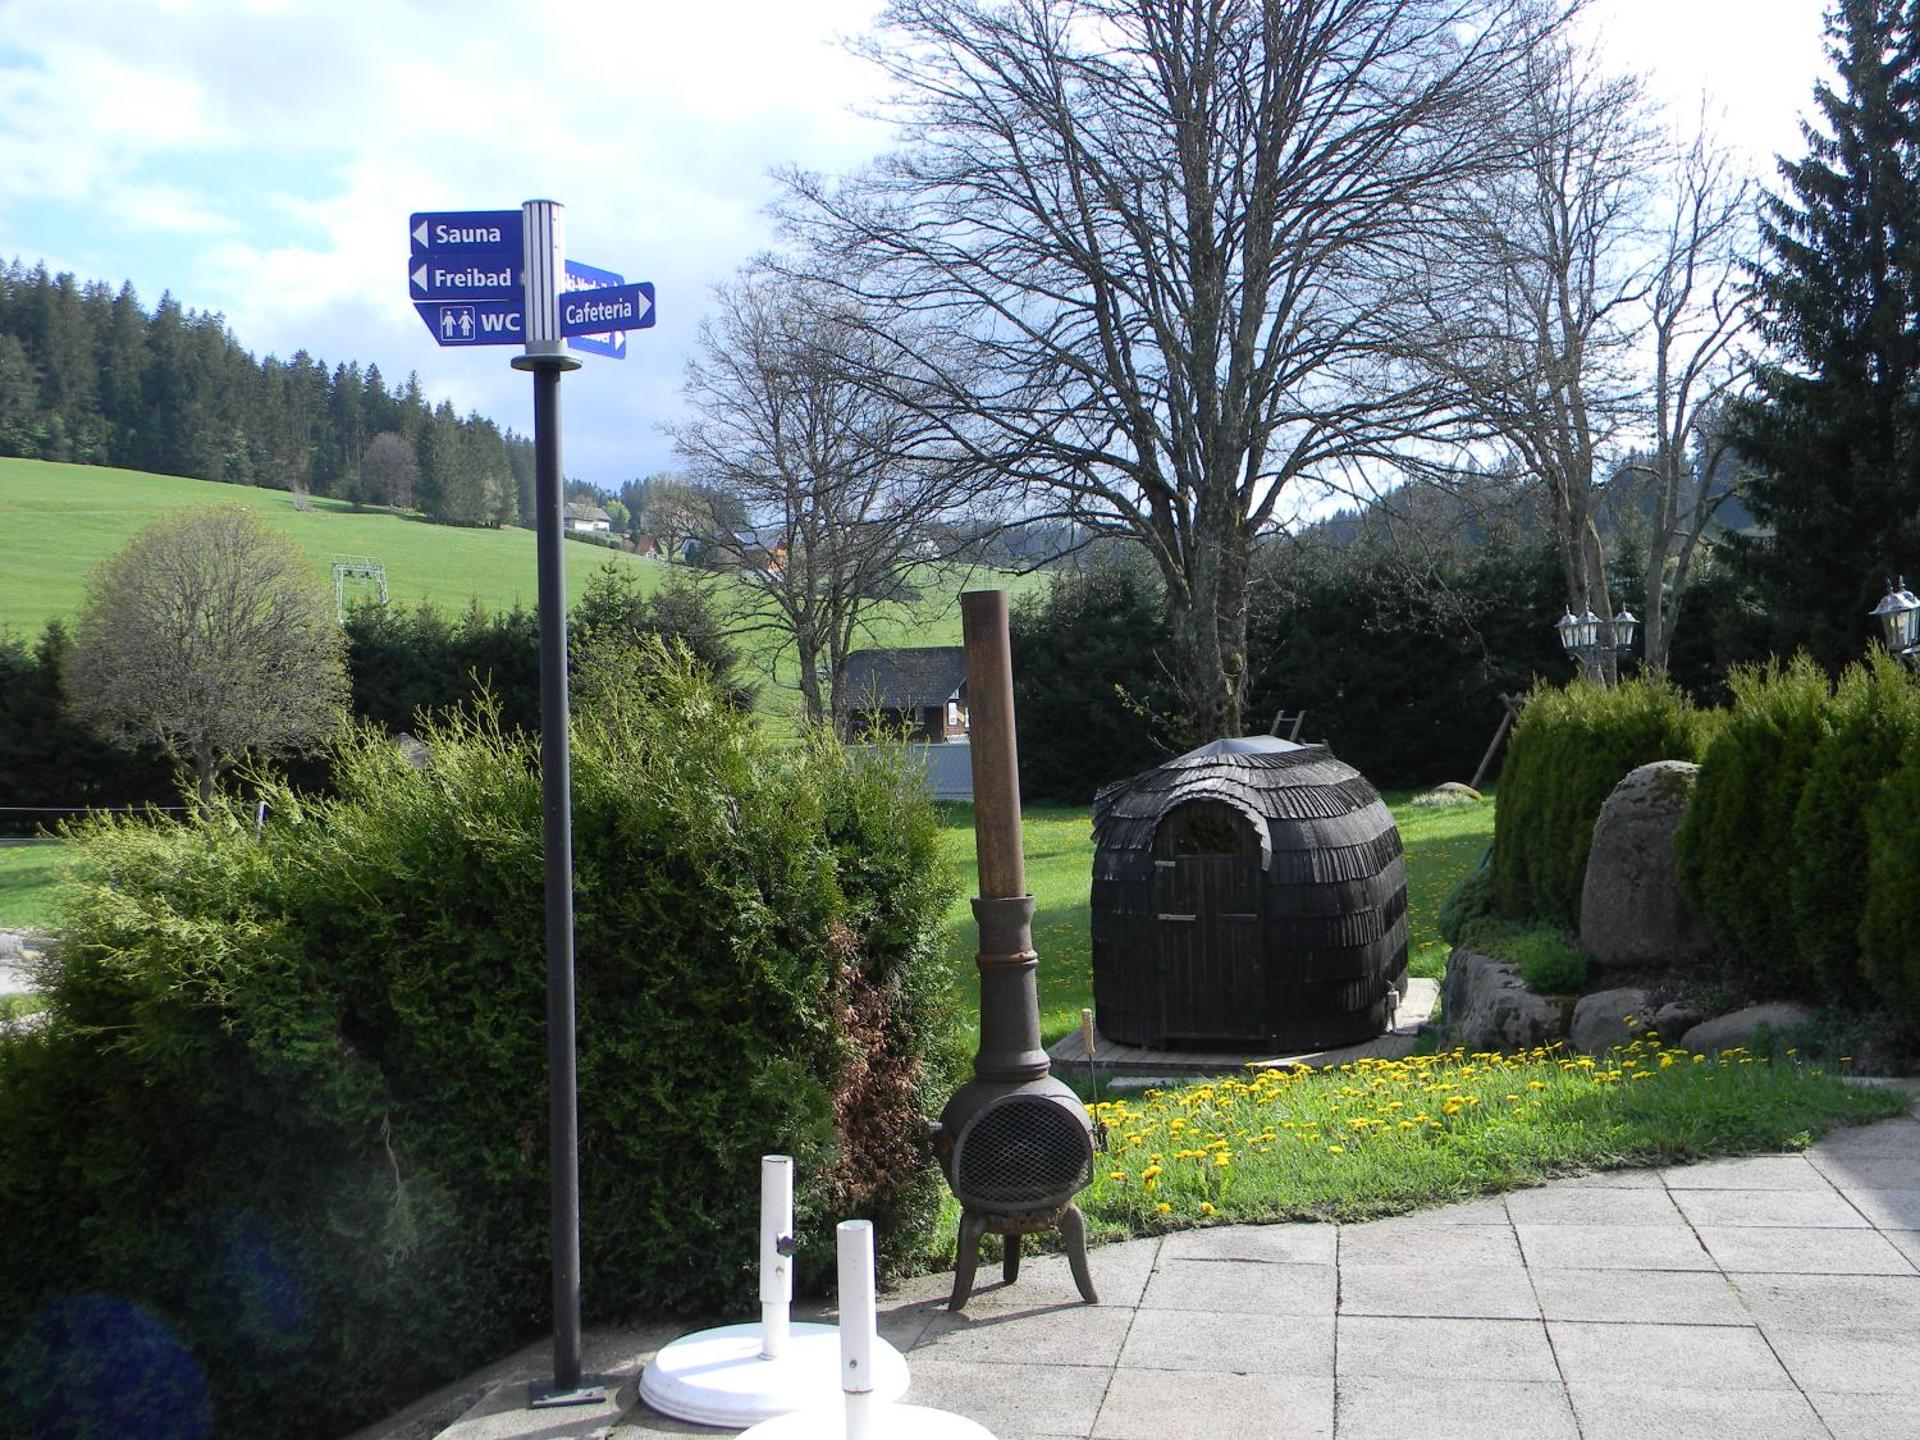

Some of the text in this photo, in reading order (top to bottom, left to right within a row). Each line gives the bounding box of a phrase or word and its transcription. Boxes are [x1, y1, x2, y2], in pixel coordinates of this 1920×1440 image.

[436, 224, 501, 244] Sauna
[435, 267, 512, 287] Freibad
[566, 297, 632, 325] Cafeteria
[480, 313, 521, 331] WC
